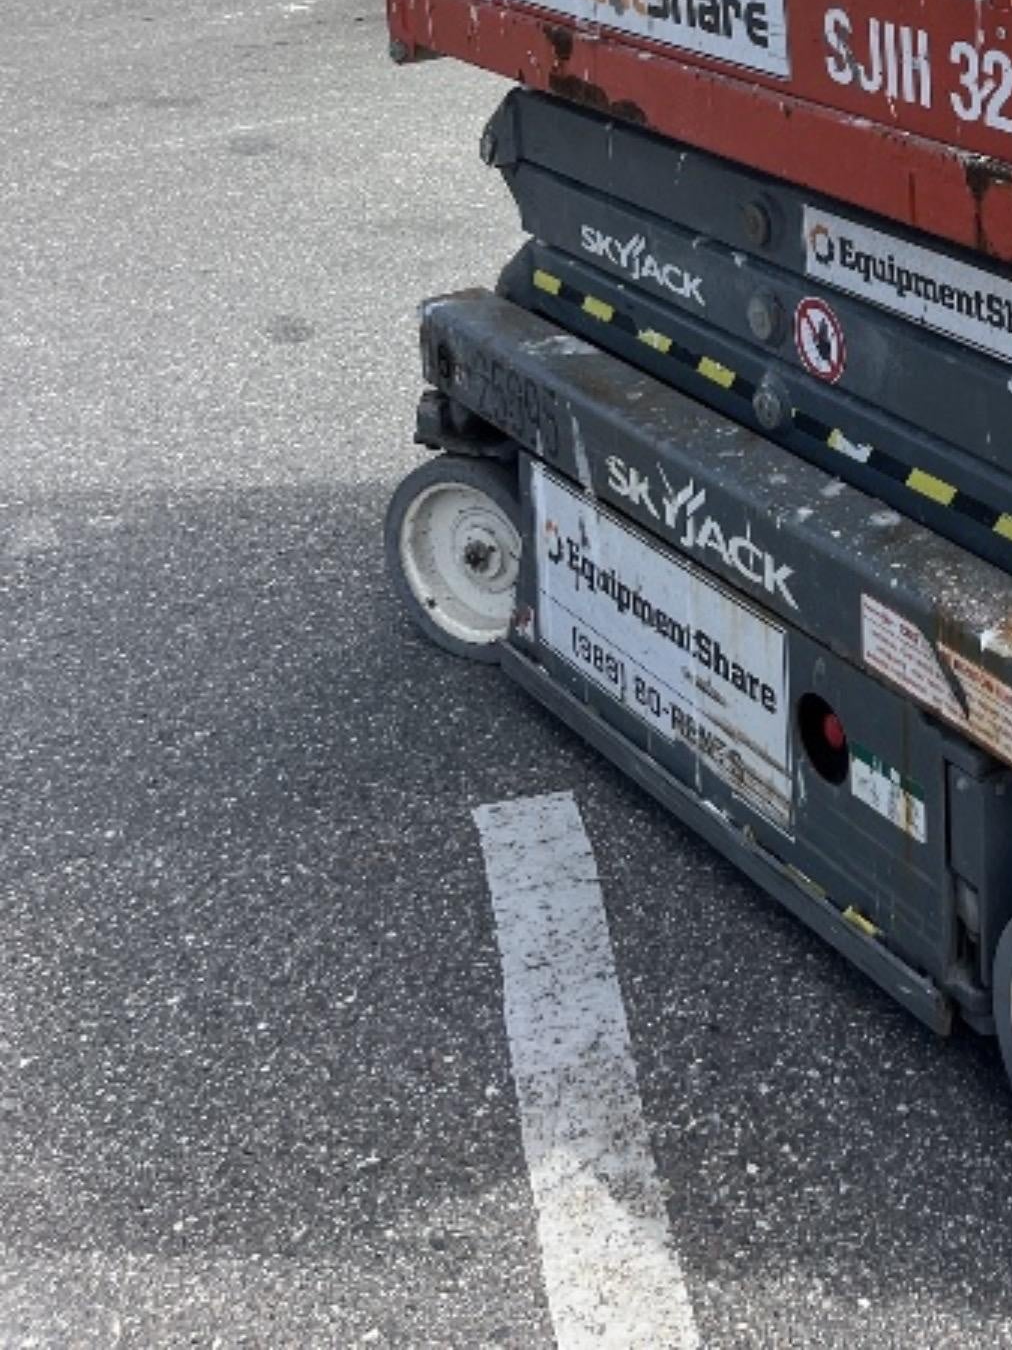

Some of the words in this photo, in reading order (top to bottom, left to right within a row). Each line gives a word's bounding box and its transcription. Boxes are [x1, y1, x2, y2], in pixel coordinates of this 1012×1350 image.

[580, 224, 706, 307] SKYJACK
[605, 455, 800, 610] SKYJACK
[566, 536, 777, 714] EquipmentShare
